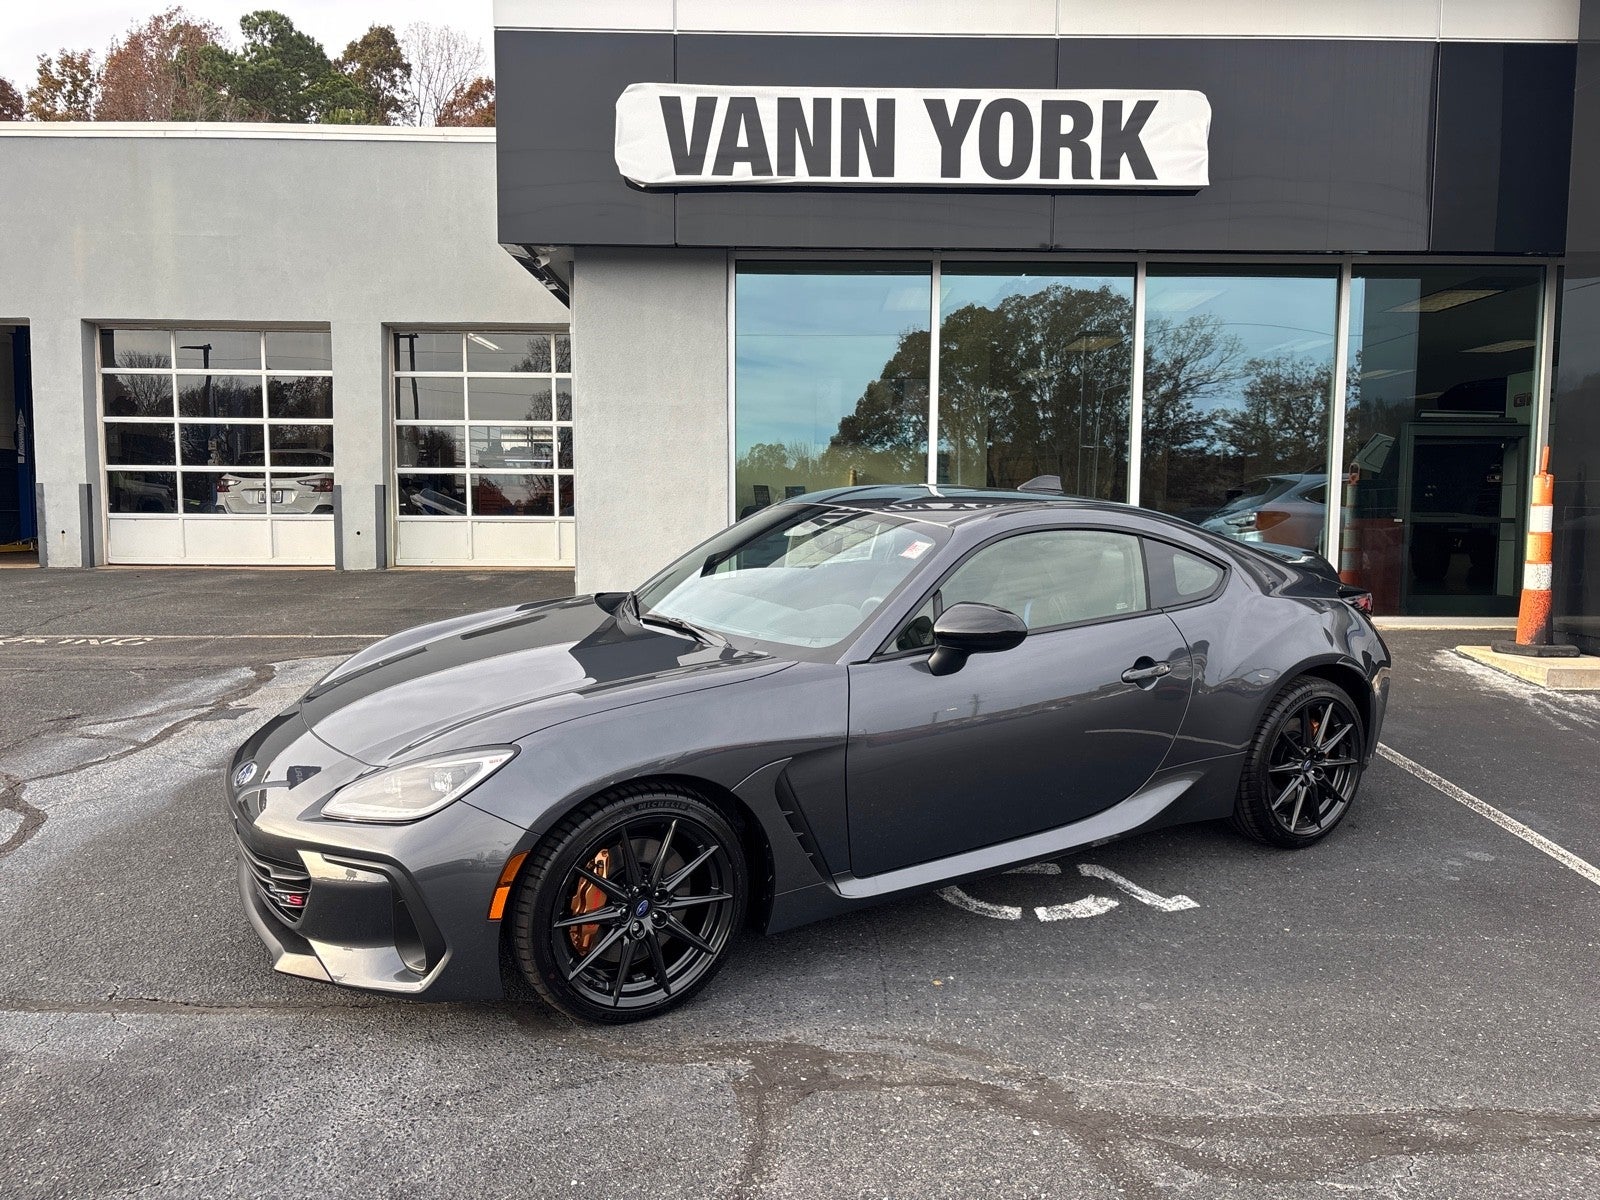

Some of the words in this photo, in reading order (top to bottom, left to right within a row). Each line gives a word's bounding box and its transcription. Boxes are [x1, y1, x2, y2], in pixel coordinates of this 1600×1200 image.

[660, 95, 895, 178] VANN
[924, 98, 1158, 180] YORK
[638, 800, 688, 810] MICHELIN
